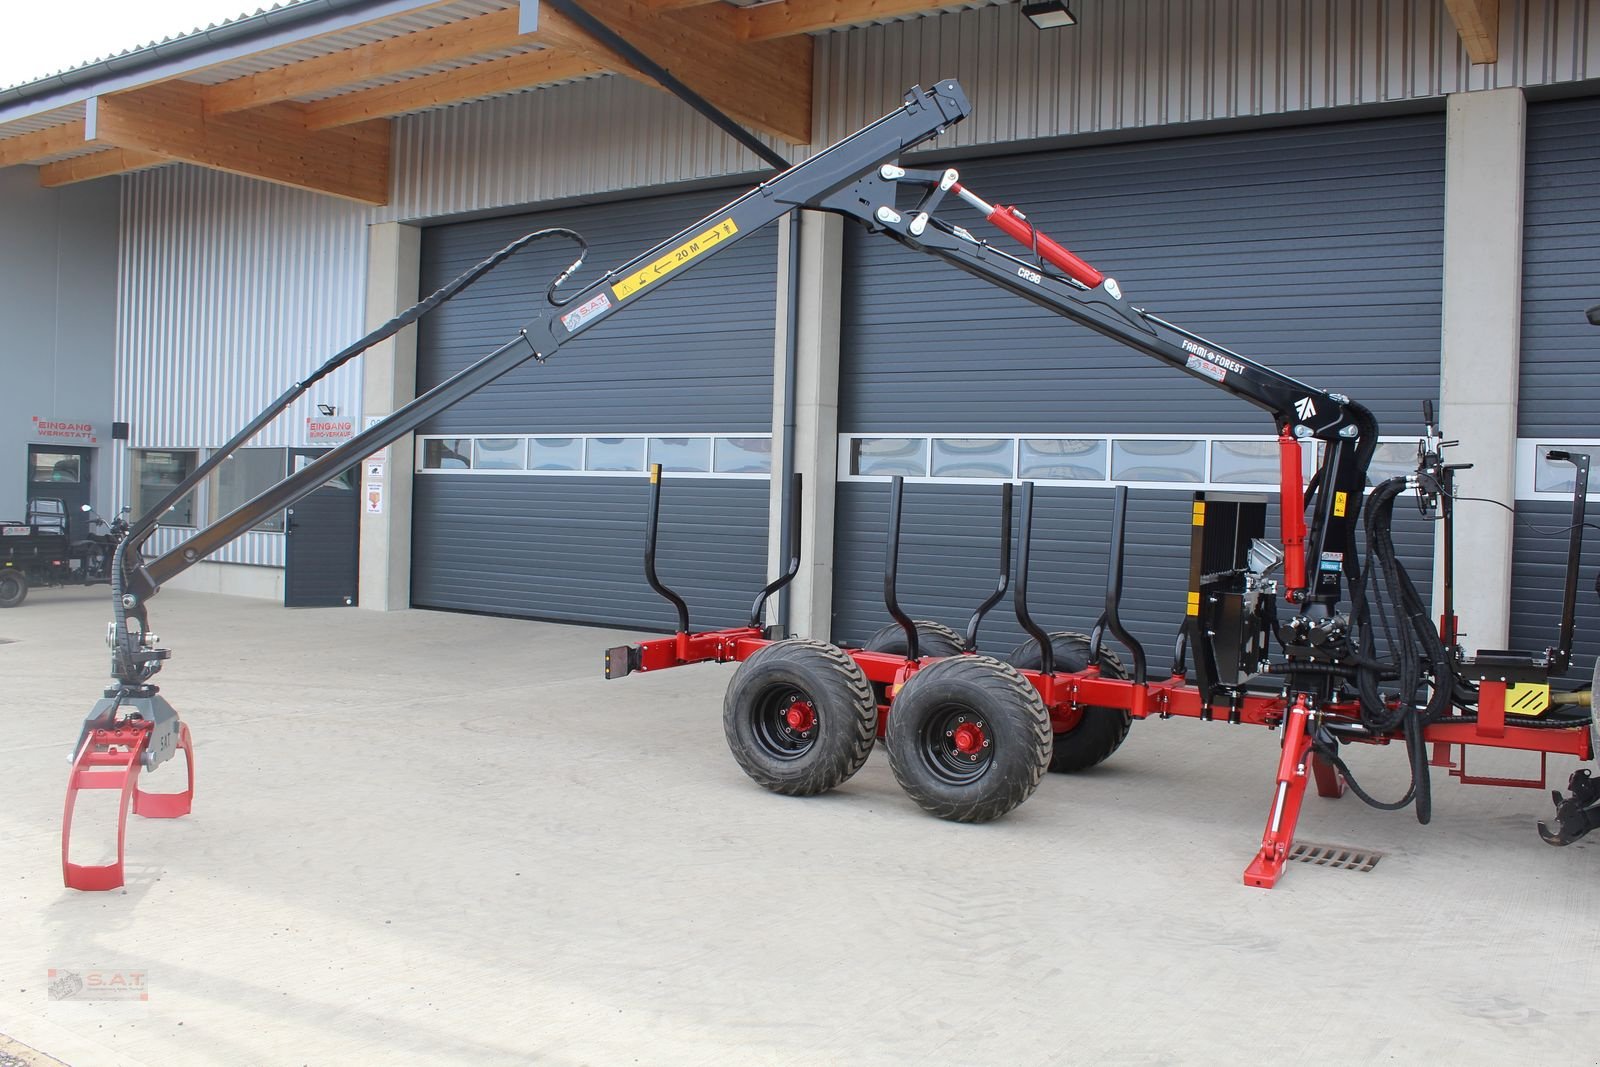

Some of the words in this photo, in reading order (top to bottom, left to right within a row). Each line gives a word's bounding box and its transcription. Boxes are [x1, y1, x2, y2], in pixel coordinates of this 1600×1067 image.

[675, 249, 689, 262] 20
[690, 242, 700, 253] M
[1181, 339, 1208, 358] FARMI
[1214, 354, 1246, 375] FOREST
[38, 421, 92, 432] EINGANG
[310, 422, 352, 431] EINGANG
[37, 430, 92, 439] WERKSTATT
